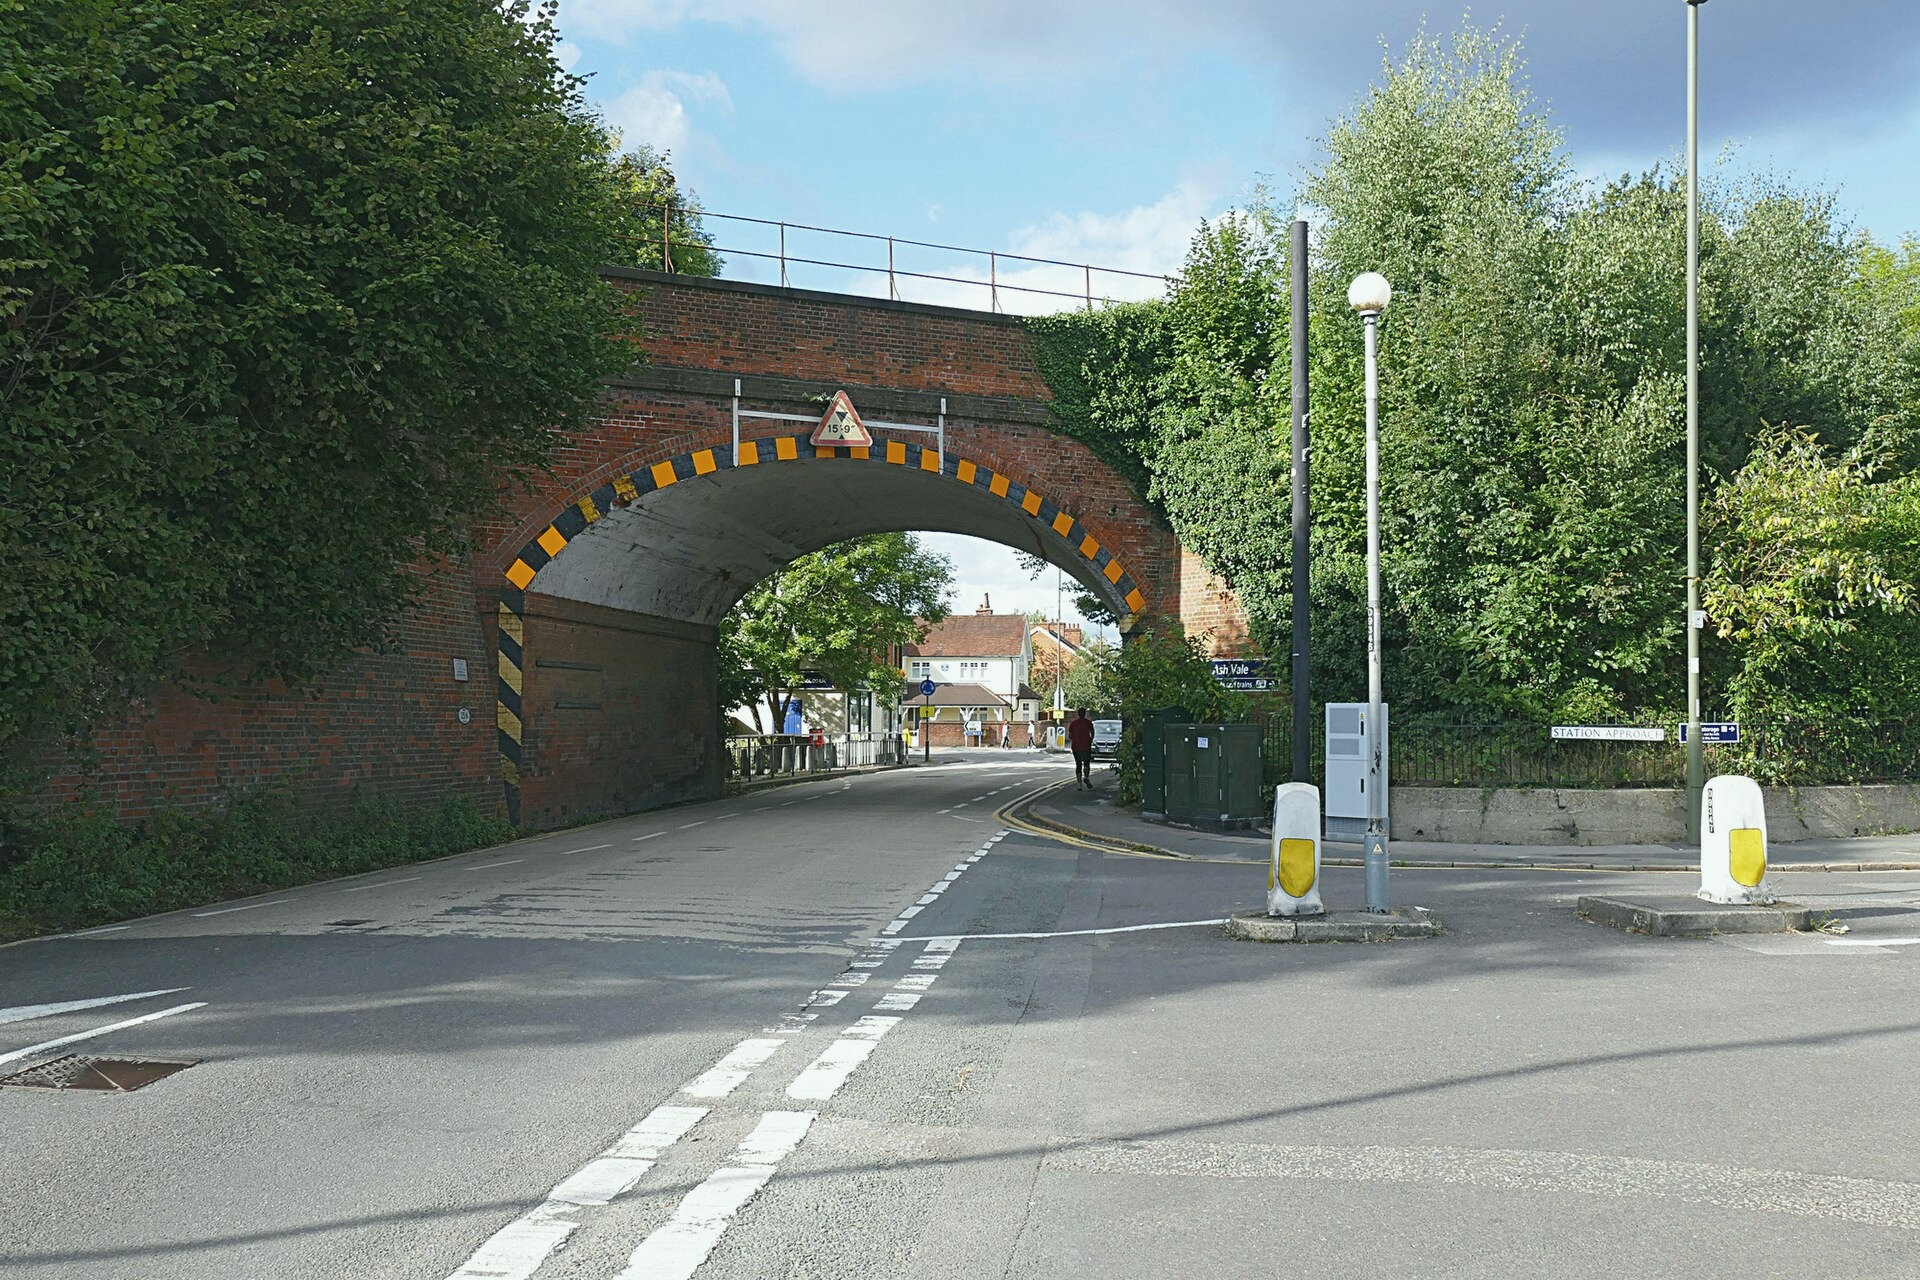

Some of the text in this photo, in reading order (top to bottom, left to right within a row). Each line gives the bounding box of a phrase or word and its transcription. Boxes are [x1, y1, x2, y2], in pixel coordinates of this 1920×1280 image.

[1211, 664, 1248, 674] Ash Vale
[1237, 680, 1253, 688] trains
[1553, 727, 1663, 740] STATION APPROACH
